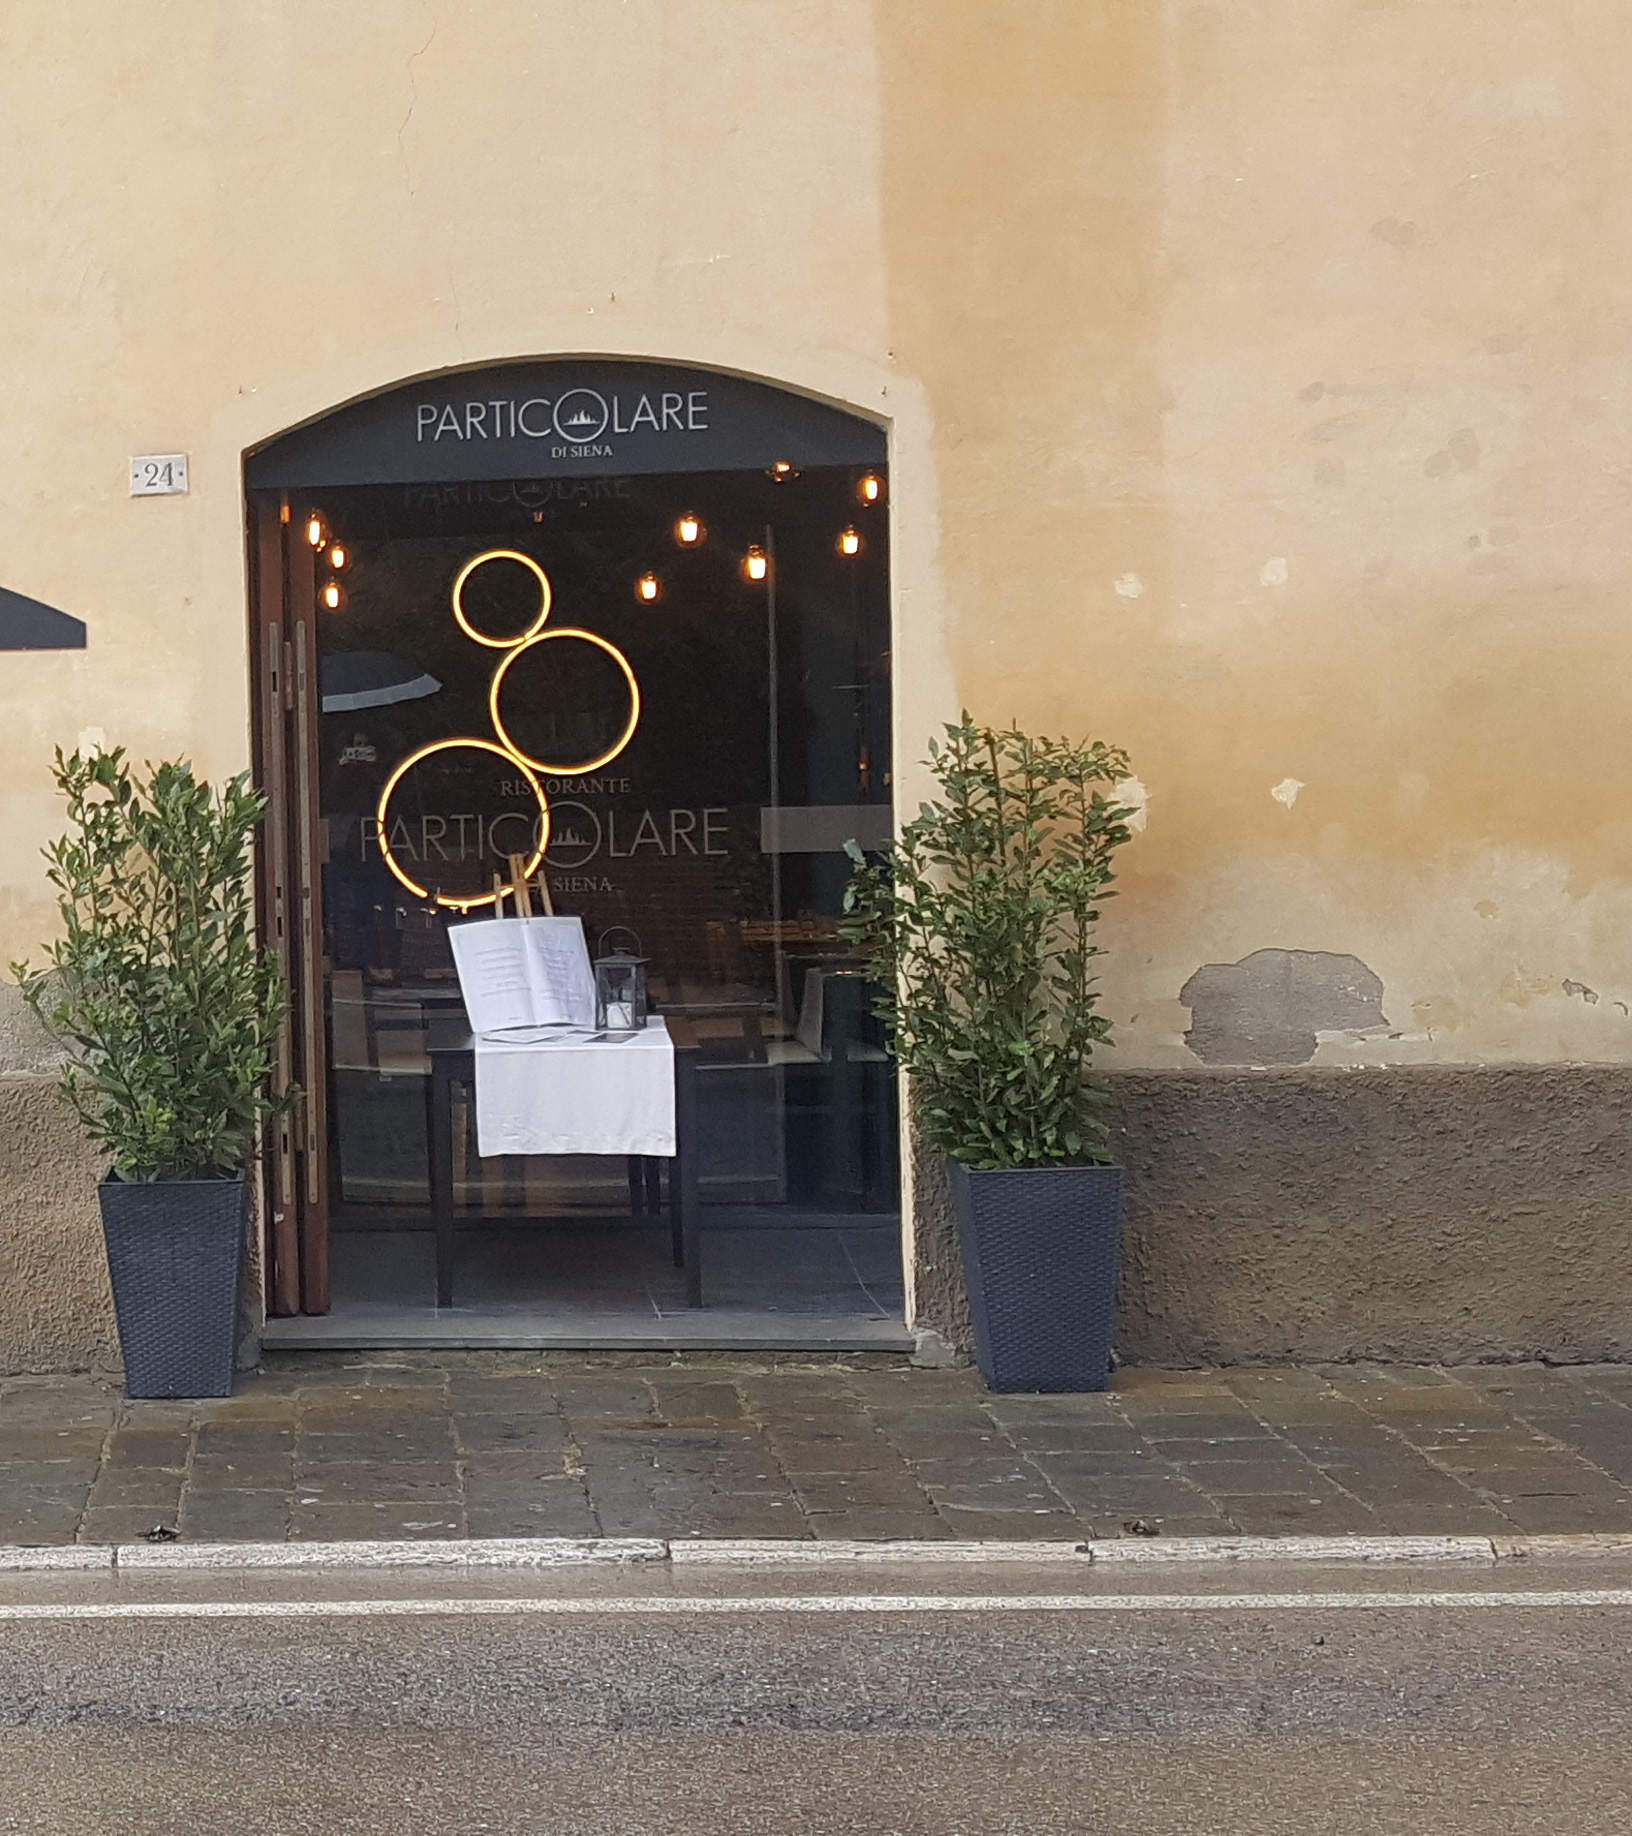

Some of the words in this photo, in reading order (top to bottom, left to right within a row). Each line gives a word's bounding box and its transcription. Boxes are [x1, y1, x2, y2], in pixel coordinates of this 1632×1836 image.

[417, 388, 709, 443] PARTICOLARE
[551, 446, 568, 459] DI
[570, 444, 614, 457] SIENA
[144, 462, 174, 487] 24
[501, 777, 631, 796] RISORANTE
[553, 876, 614, 892] SIENA
